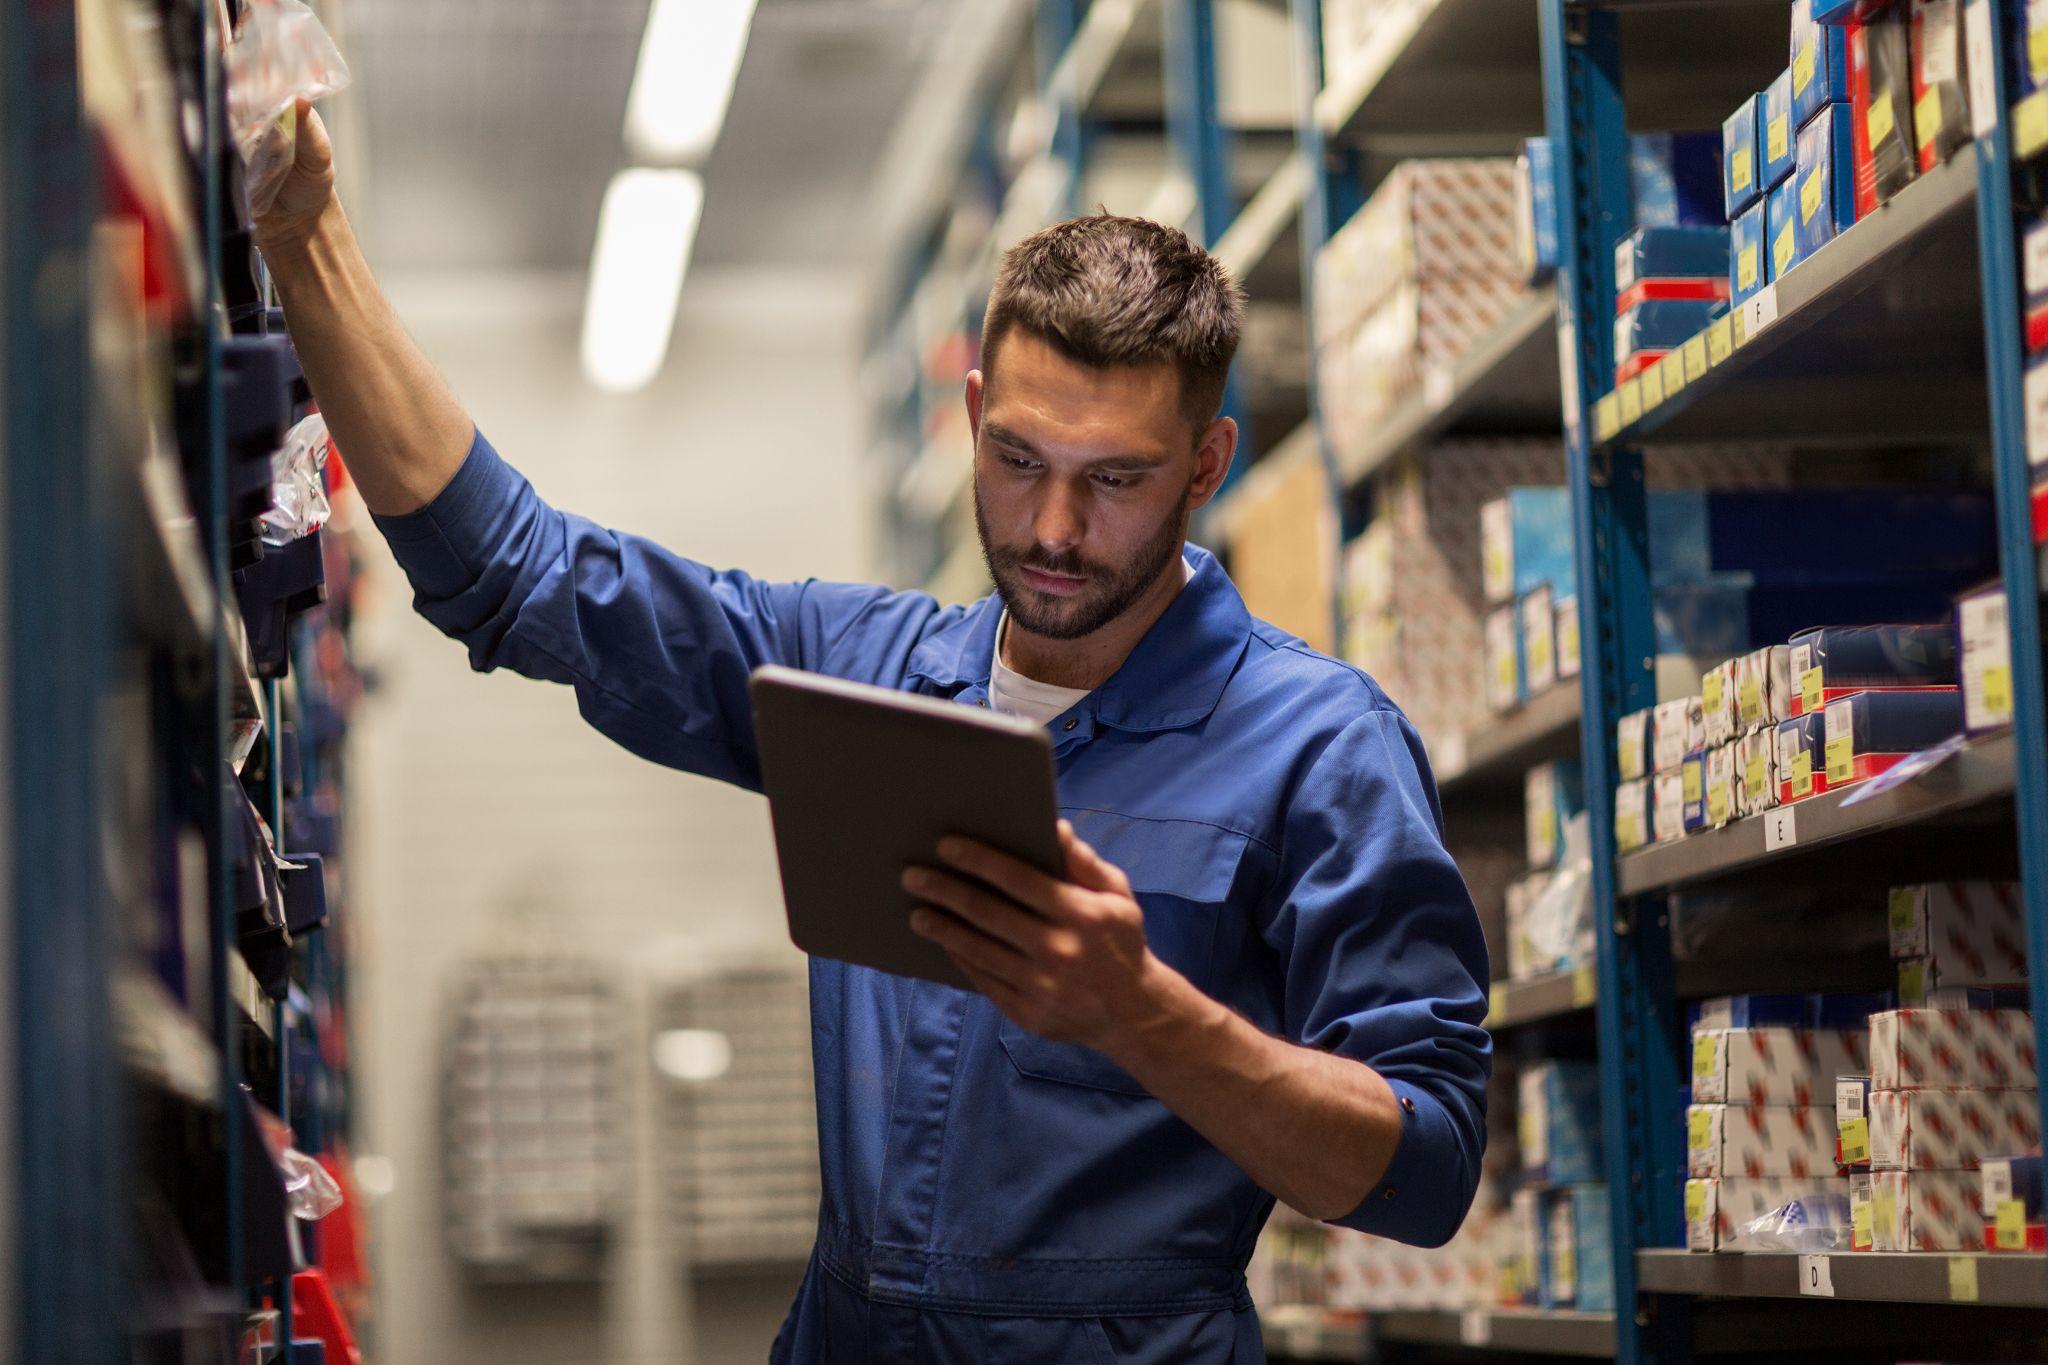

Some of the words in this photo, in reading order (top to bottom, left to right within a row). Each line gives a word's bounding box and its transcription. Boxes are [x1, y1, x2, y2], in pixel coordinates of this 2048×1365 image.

[1756, 302, 1761, 324] F
[1778, 820, 1783, 841] E
[1811, 1266, 1818, 1288] D
